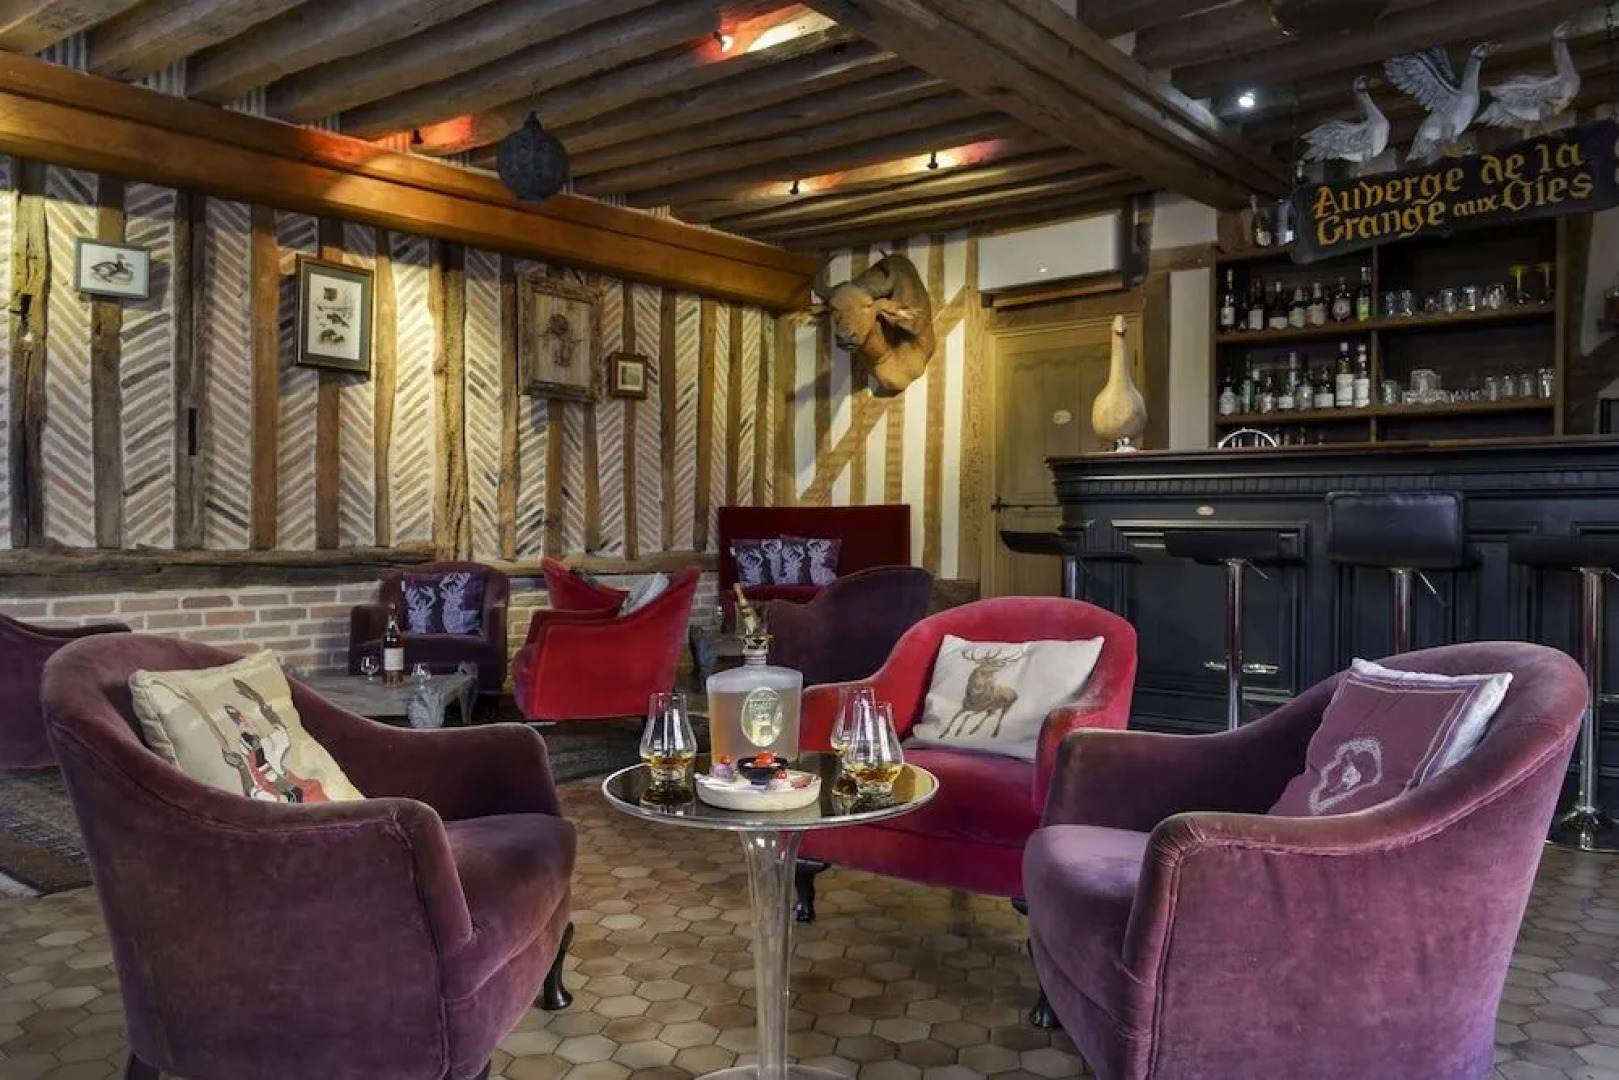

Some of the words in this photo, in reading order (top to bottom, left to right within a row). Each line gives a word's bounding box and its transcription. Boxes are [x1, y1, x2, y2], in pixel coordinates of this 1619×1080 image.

[1313, 166, 1464, 219] Auberge
[1481, 153, 1525, 184] de
[1536, 143, 1582, 171] la
[1316, 201, 1446, 246] Grange
[1453, 194, 1499, 217] aux
[1501, 172, 1594, 212] Oies
